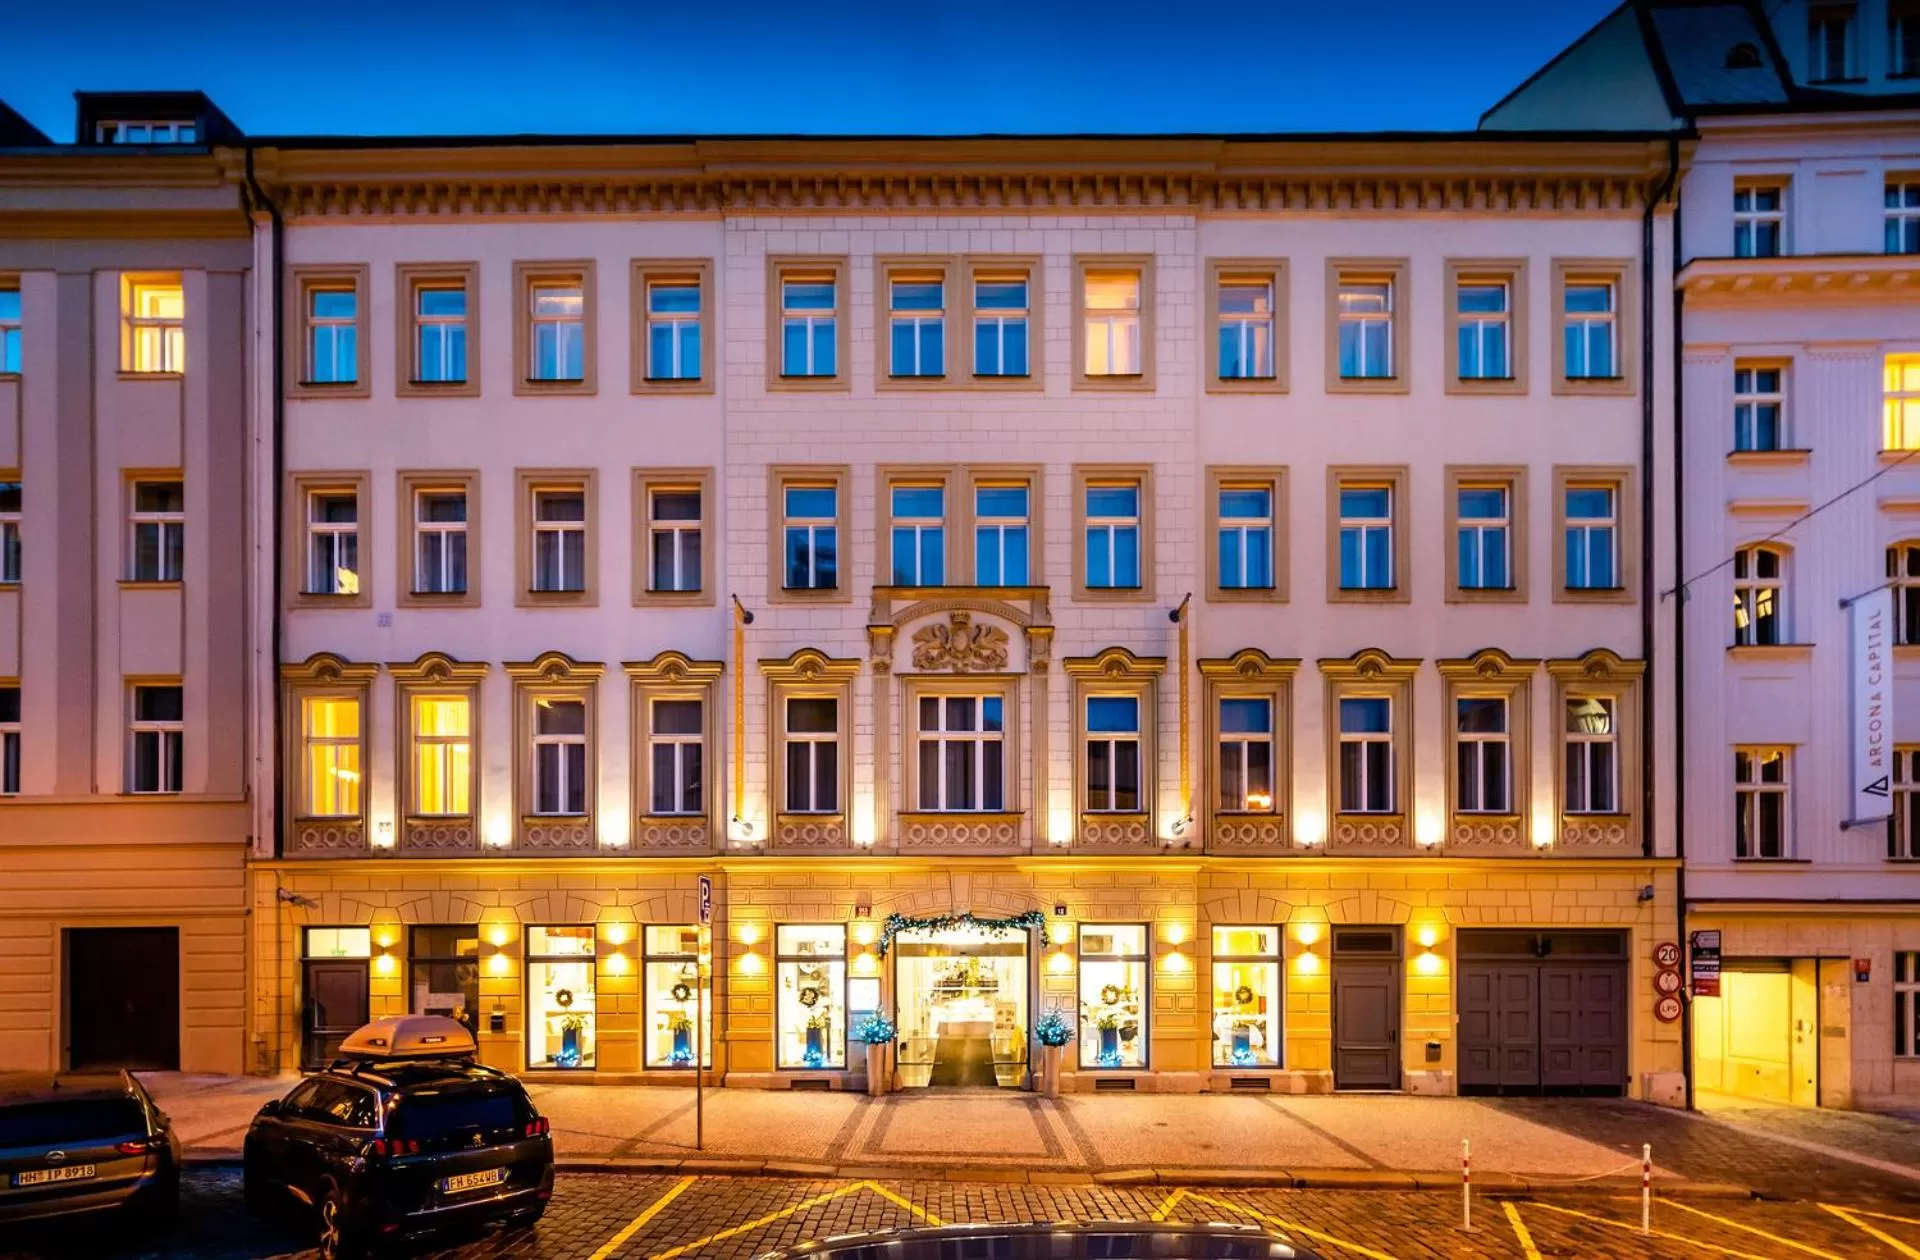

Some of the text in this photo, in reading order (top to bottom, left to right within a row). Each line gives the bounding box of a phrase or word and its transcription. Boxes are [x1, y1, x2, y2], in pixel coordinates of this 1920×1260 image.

[1868, 609, 1882, 766] ARCONA CAPITAL
[1661, 948, 1678, 961] 20
[20, 1172, 36, 1183] HH
[65, 1166, 93, 1178] 8918
[450, 1176, 463, 1188] FH
